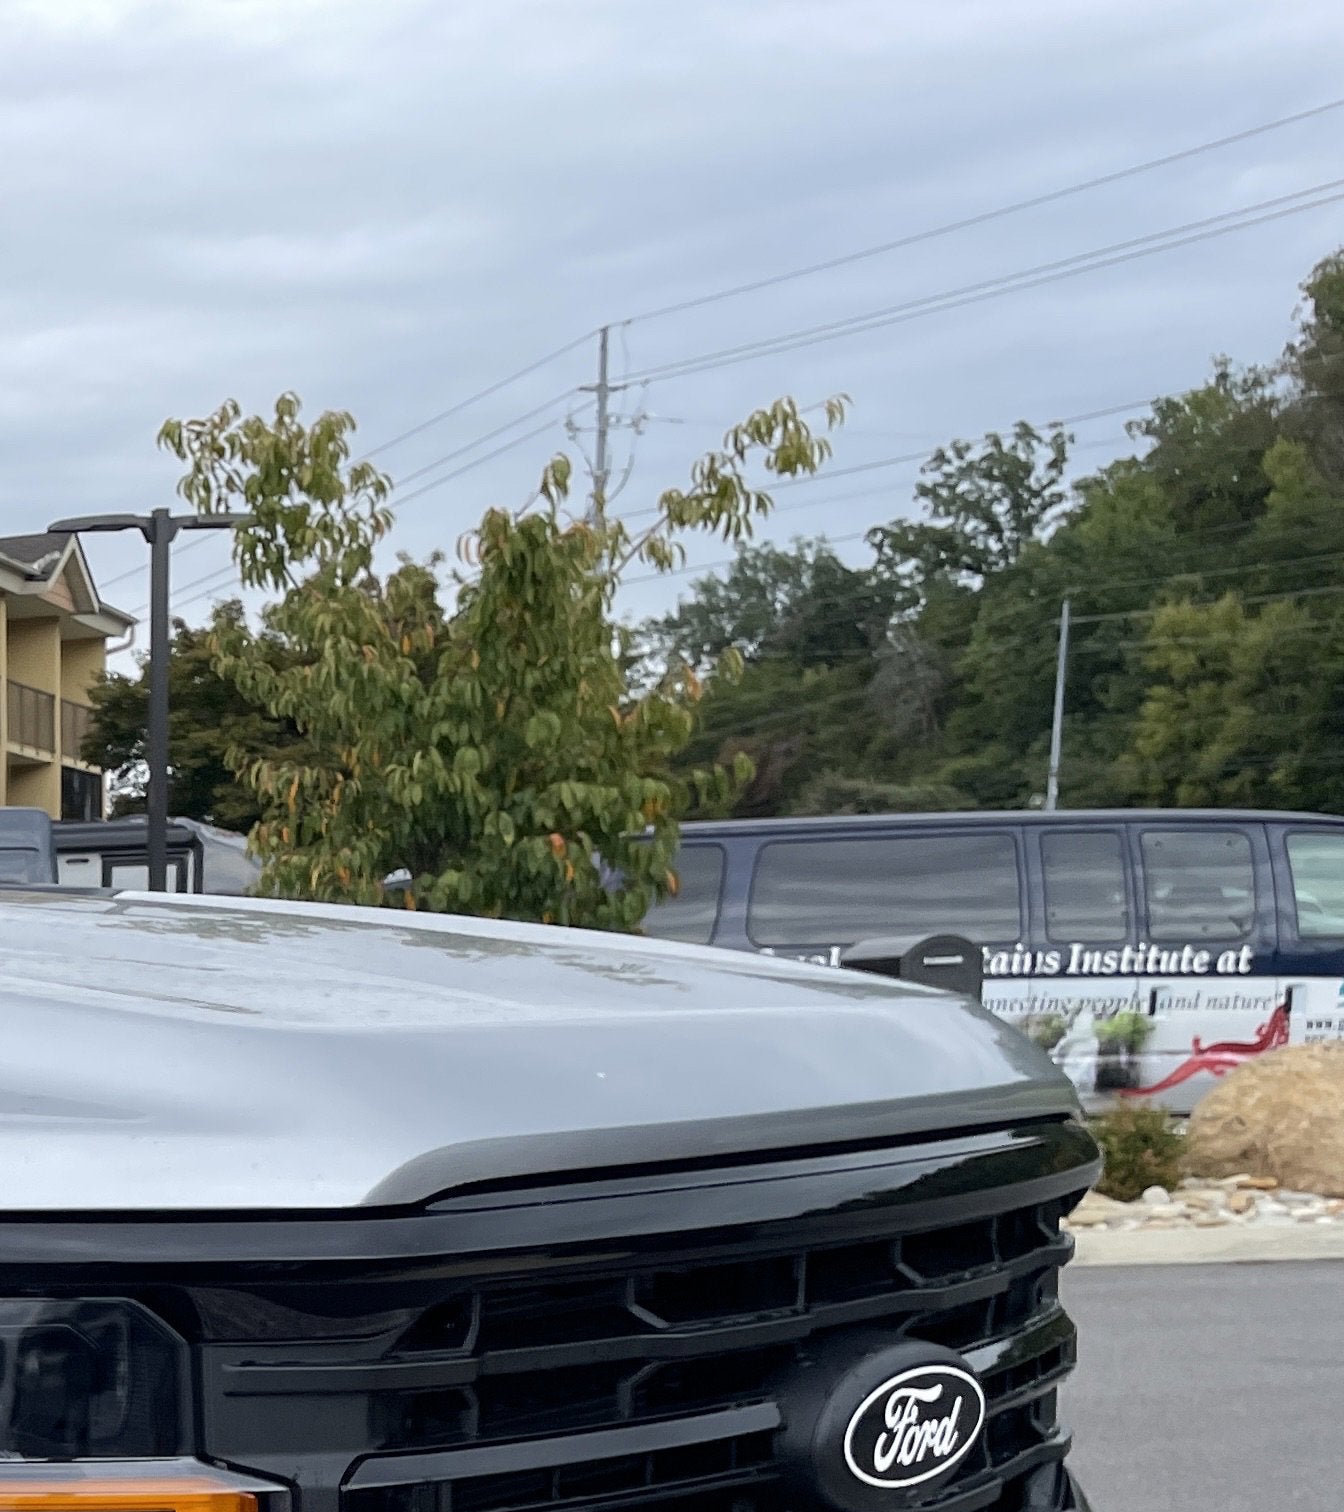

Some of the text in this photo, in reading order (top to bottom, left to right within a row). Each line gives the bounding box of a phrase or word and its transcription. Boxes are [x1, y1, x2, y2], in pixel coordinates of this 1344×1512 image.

[1066, 942, 1210, 975] Institute
[1216, 944, 1254, 974] at
[1159, 990, 1201, 1011] and
[874, 1384, 962, 1472] Ford
